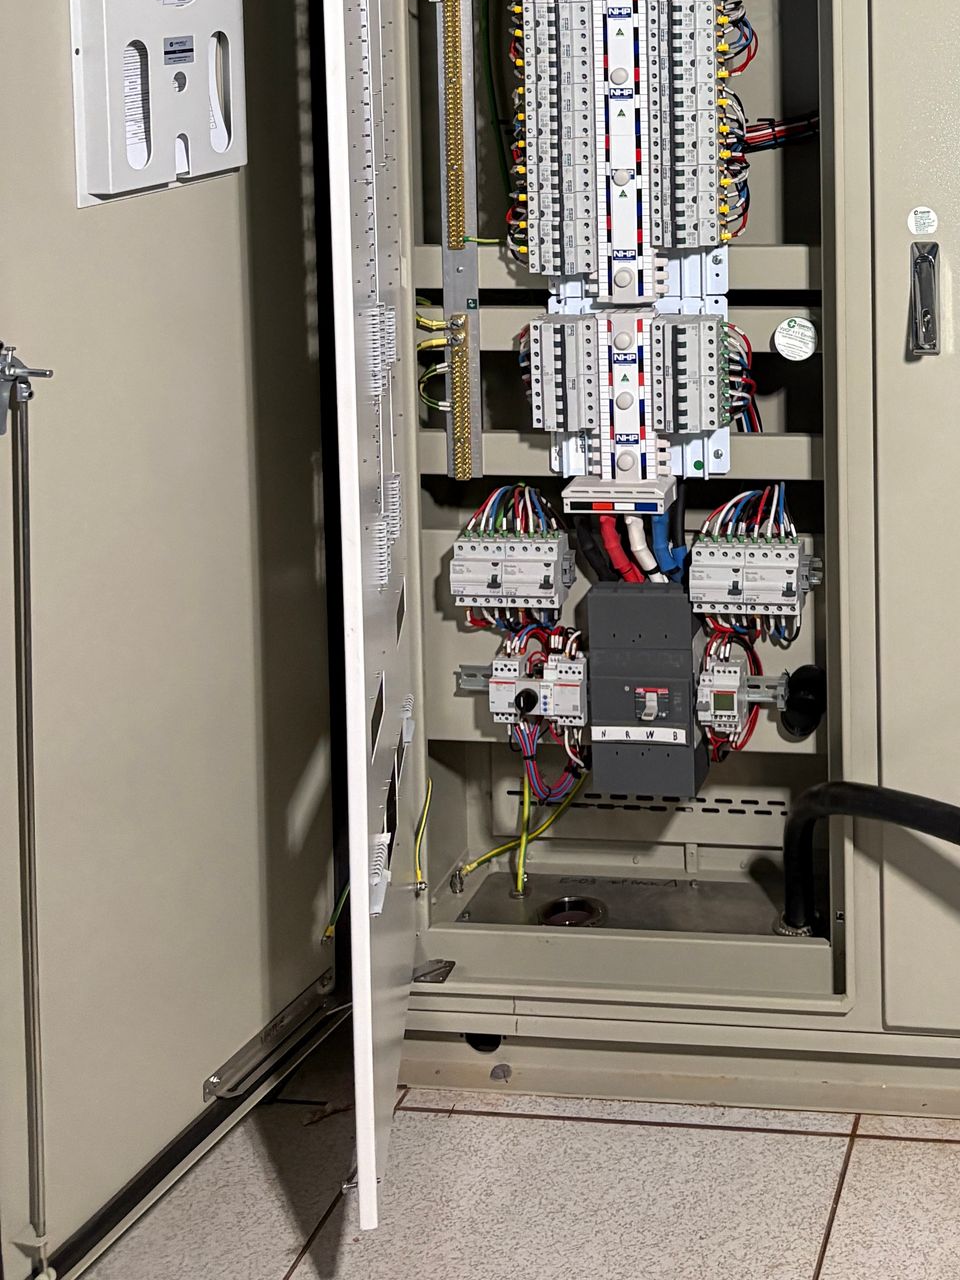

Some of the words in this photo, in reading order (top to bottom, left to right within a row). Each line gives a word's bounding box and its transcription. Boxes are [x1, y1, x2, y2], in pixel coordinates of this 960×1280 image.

[608, 7, 631, 15] NHP
[610, 88, 633, 96] NHP
[613, 250, 636, 258] NHP
[613, 353, 636, 361] NHP
[616, 434, 639, 442] NHP
[601, 729, 607, 738] N
[625, 730, 631, 739] R
[645, 730, 655, 740] W
[672, 730, 678, 741] B
